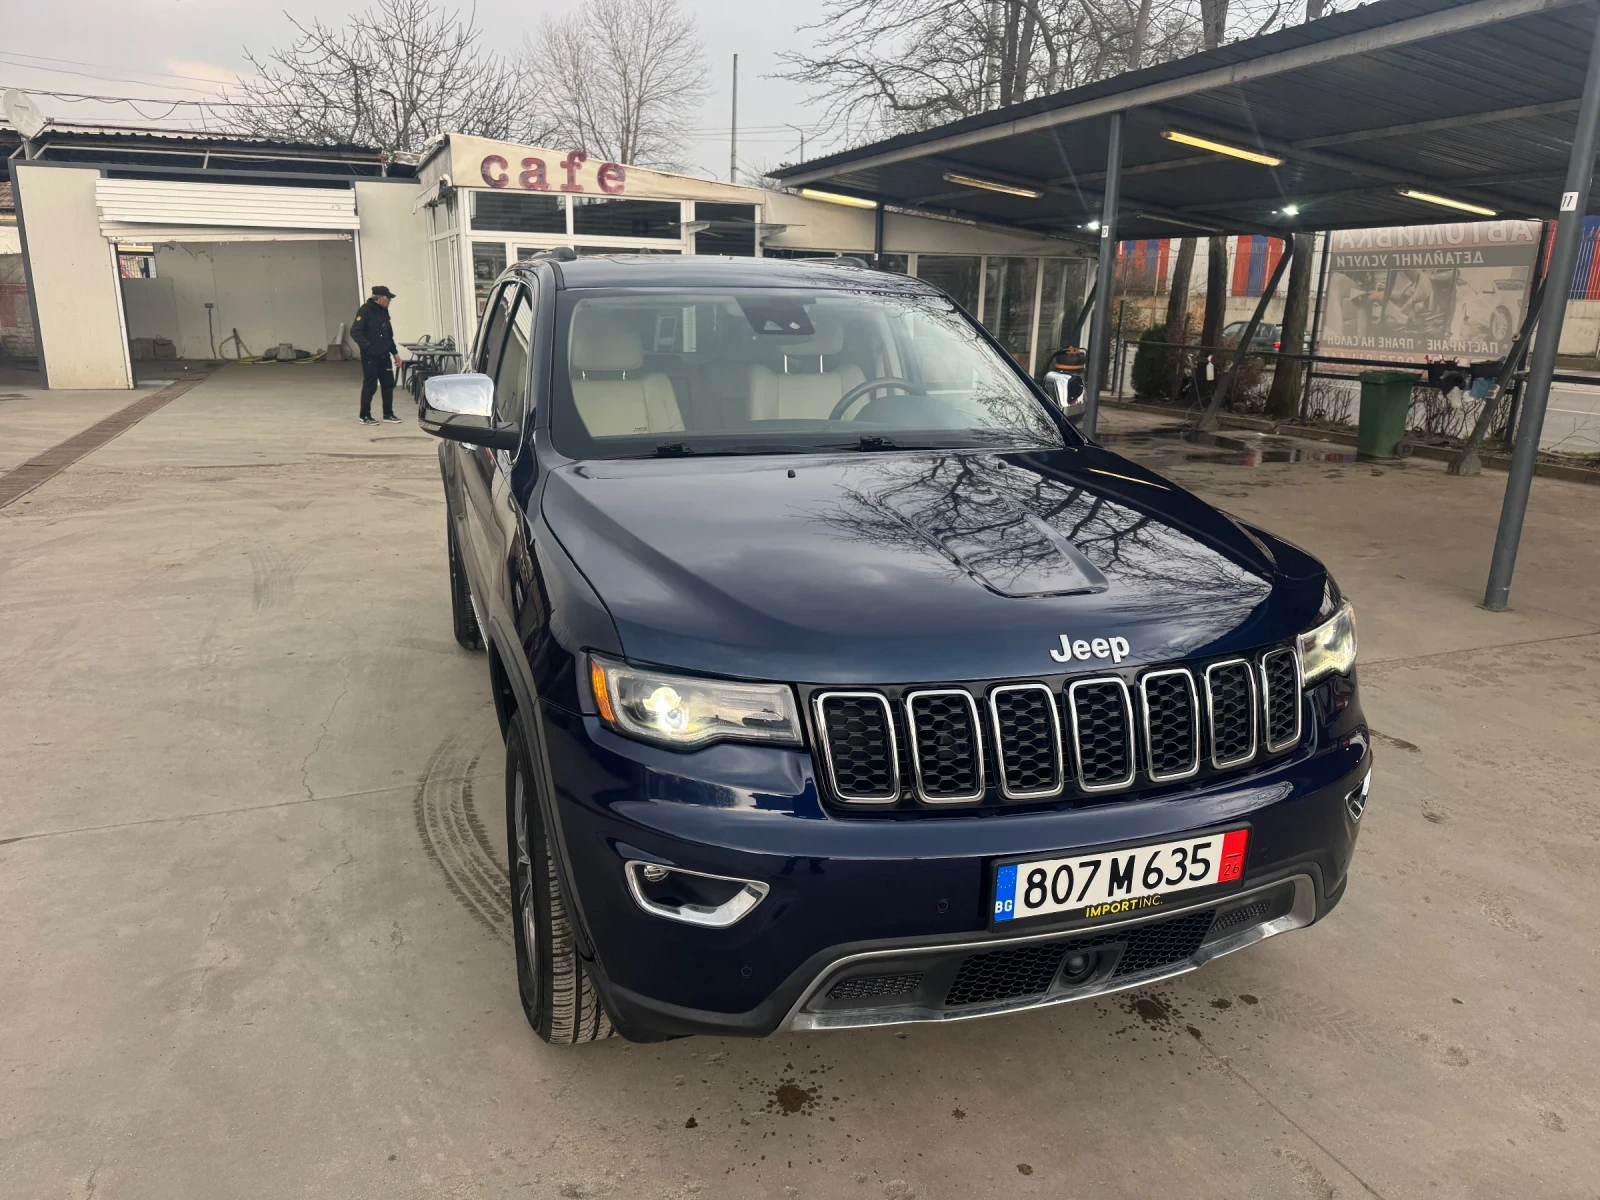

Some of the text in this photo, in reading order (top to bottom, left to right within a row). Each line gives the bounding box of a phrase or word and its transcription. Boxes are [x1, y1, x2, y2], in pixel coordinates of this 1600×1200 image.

[480, 150, 626, 195] cafe
[1049, 634, 1130, 664] Jeep
[1023, 841, 1212, 909] 807 M 635
[1223, 862, 1240, 877] 26
[994, 899, 1013, 914] BG
